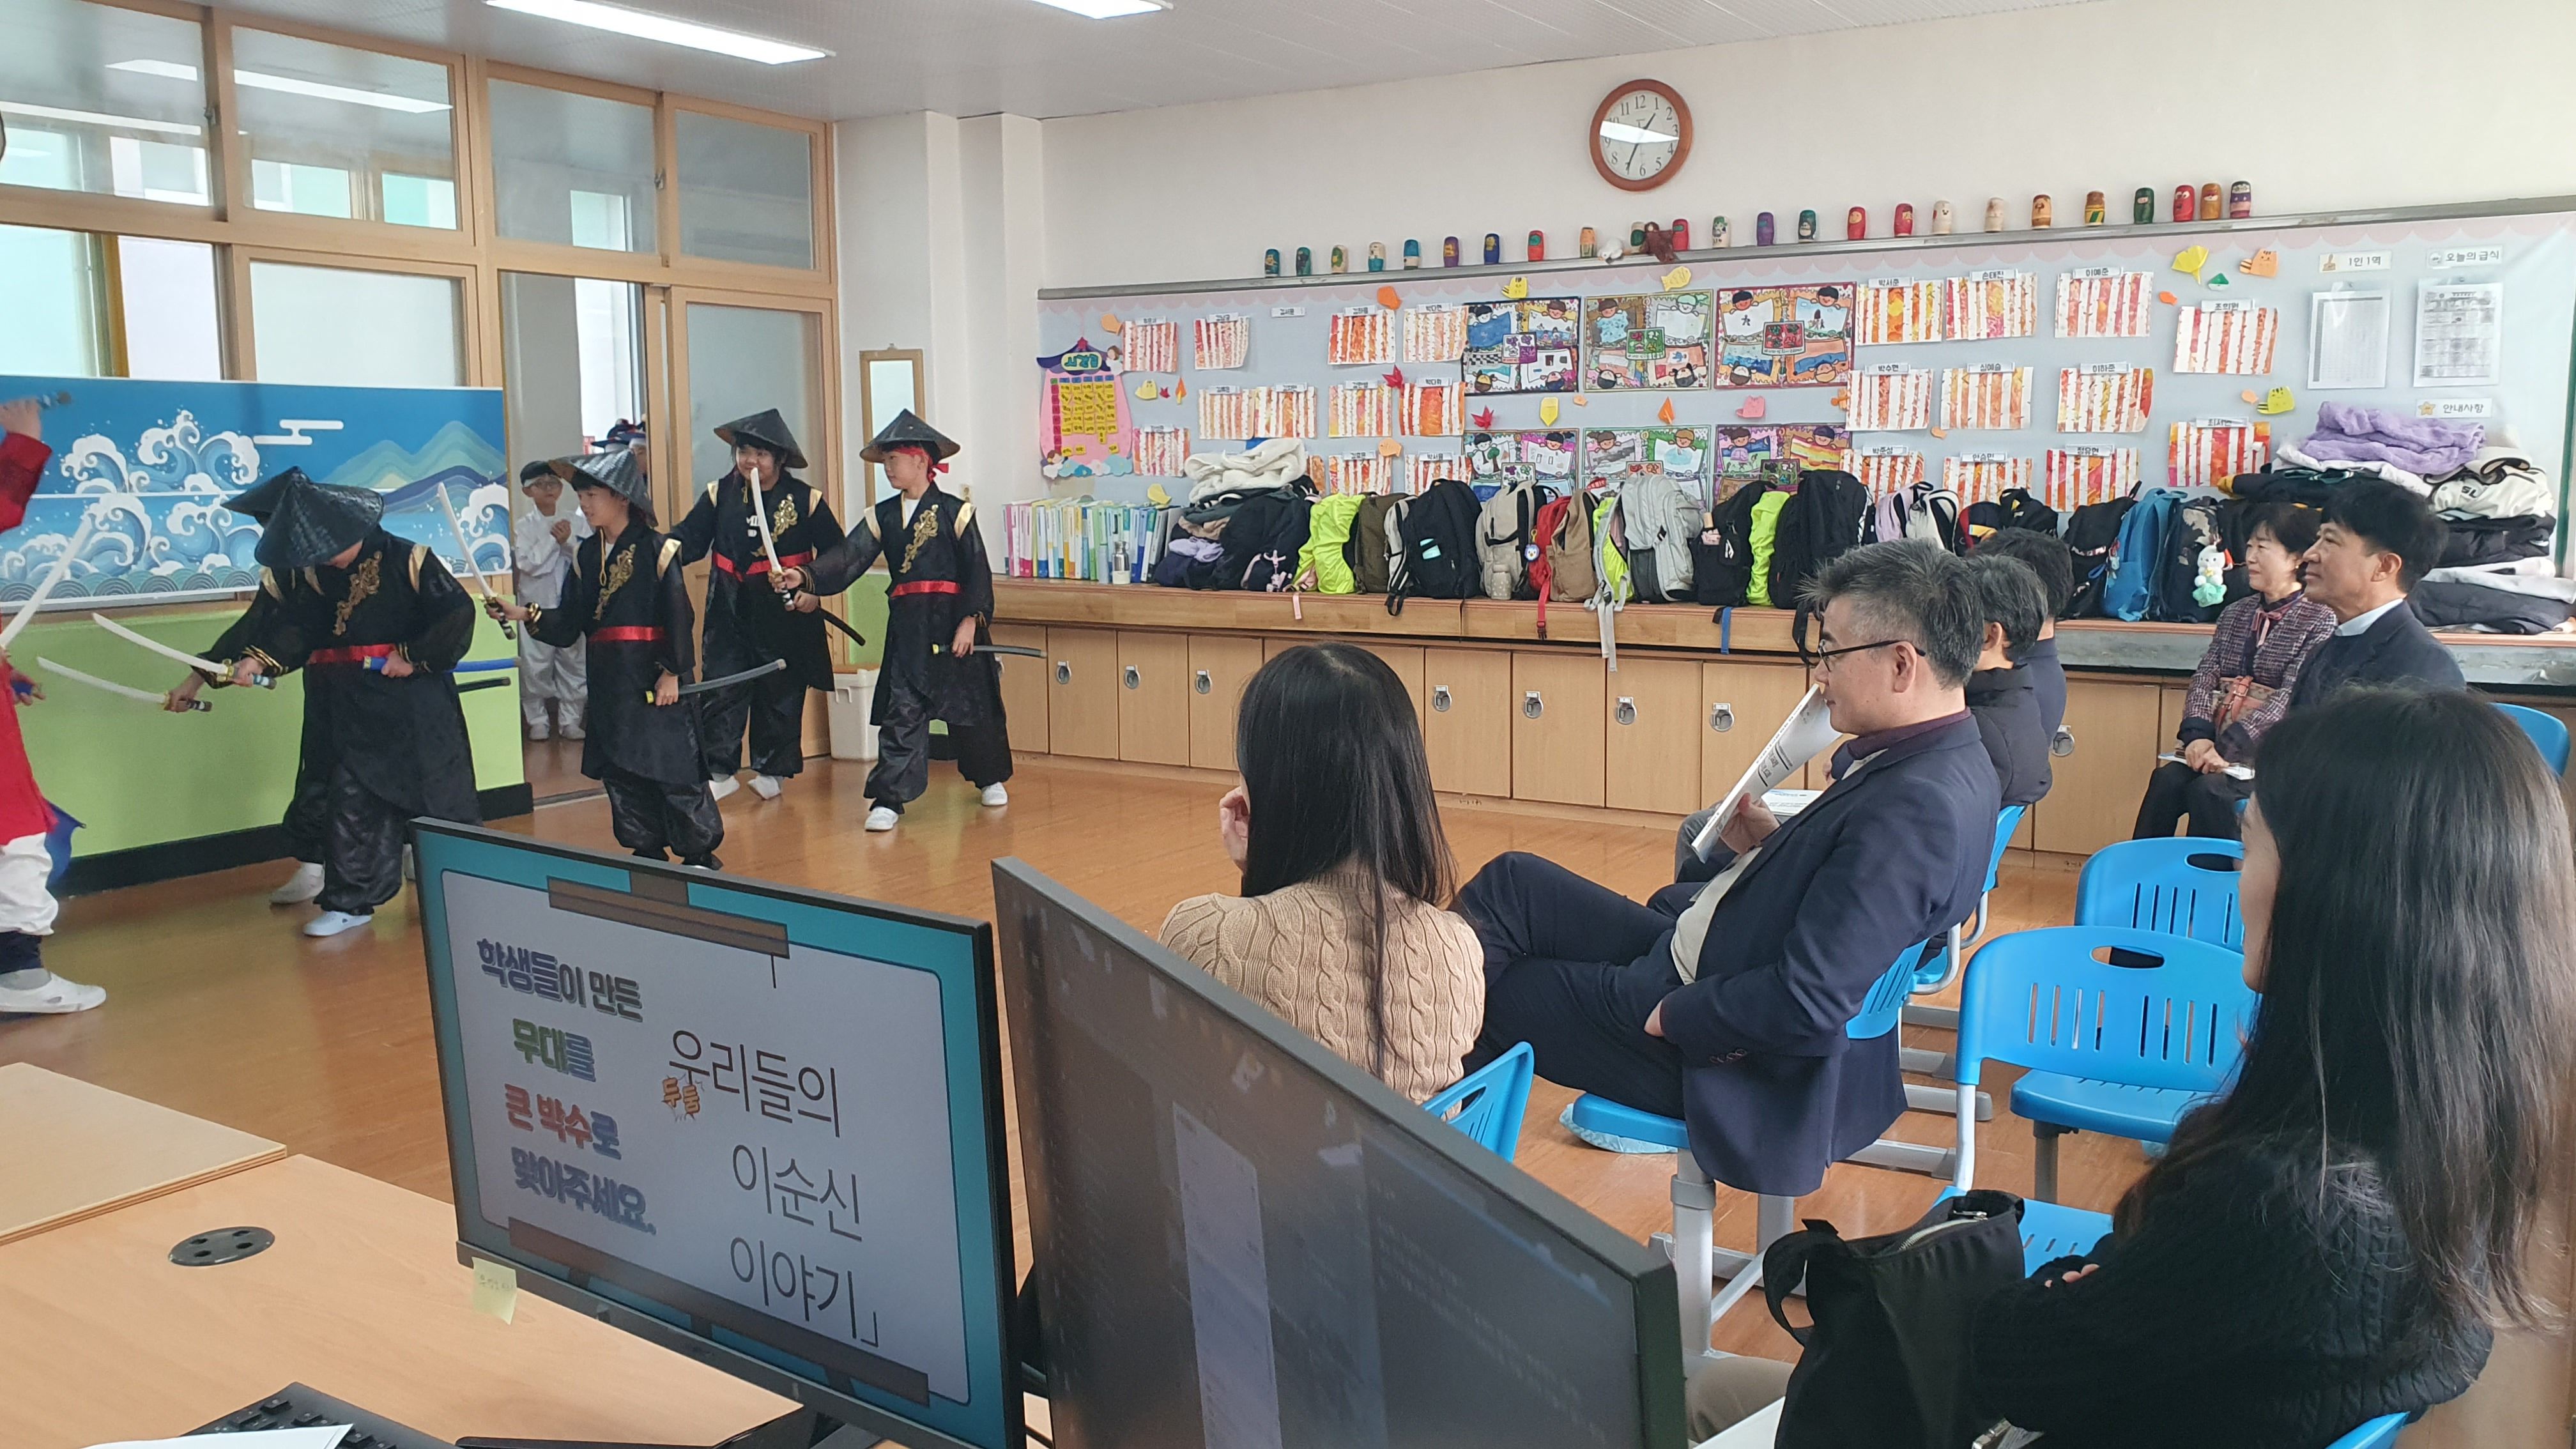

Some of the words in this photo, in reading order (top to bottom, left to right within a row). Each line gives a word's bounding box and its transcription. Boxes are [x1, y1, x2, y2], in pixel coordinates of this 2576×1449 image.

[1620, 102, 1631, 116] 11
[1634, 94, 1646, 111] 12
[1666, 106, 1673, 121] 2
[1672, 124, 1678, 137] 3
[1667, 142, 1675, 155] 4
[1611, 151, 1618, 165] 8
[1655, 157, 1662, 172] 5
[1639, 164, 1646, 176] 6
[2444, 252, 2477, 263] 오늘의
[2479, 250, 2499, 261] 급식
[2442, 403, 2485, 414] 안내사항
[477, 937, 586, 1001] 학생들이
[587, 967, 644, 1022] 만든
[511, 1017, 597, 1083] 무대를
[668, 1029, 841, 1138] 우리들의
[504, 1082, 534, 1133] 큰
[534, 1094, 622, 1160] 박수로
[510, 1147, 657, 1236] 맞아주세요.
[732, 1142, 863, 1242] 이순신
